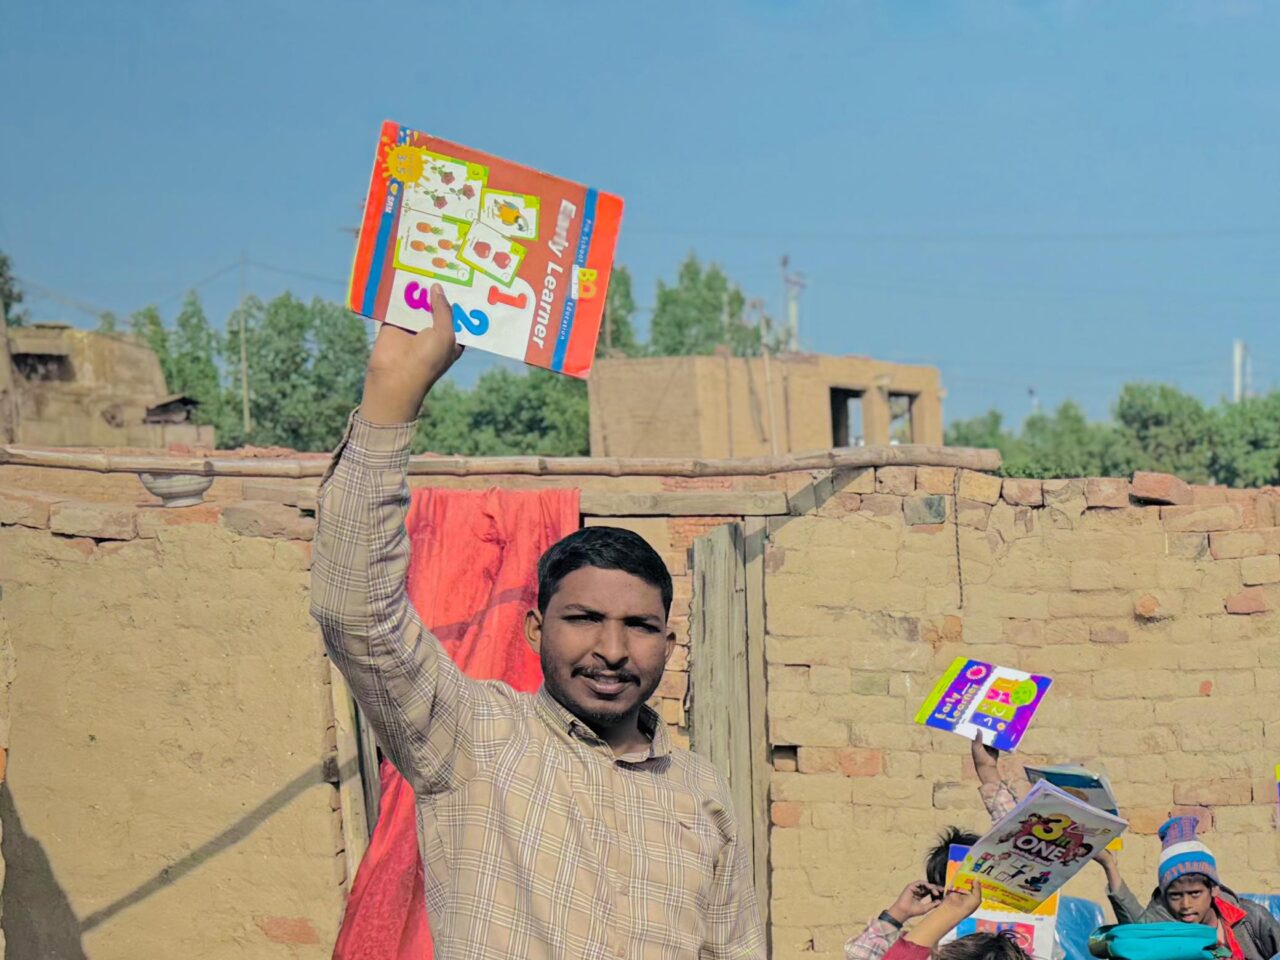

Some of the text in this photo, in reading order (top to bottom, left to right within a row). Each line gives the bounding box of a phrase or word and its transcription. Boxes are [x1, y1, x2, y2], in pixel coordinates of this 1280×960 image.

[531, 198, 577, 349] Early Learner
[487, 285, 528, 310] 1
[451, 302, 490, 336] 2
[934, 692, 962, 719] Early
[1031, 812, 1072, 841] 3
[1015, 835, 1066, 862] ONE
